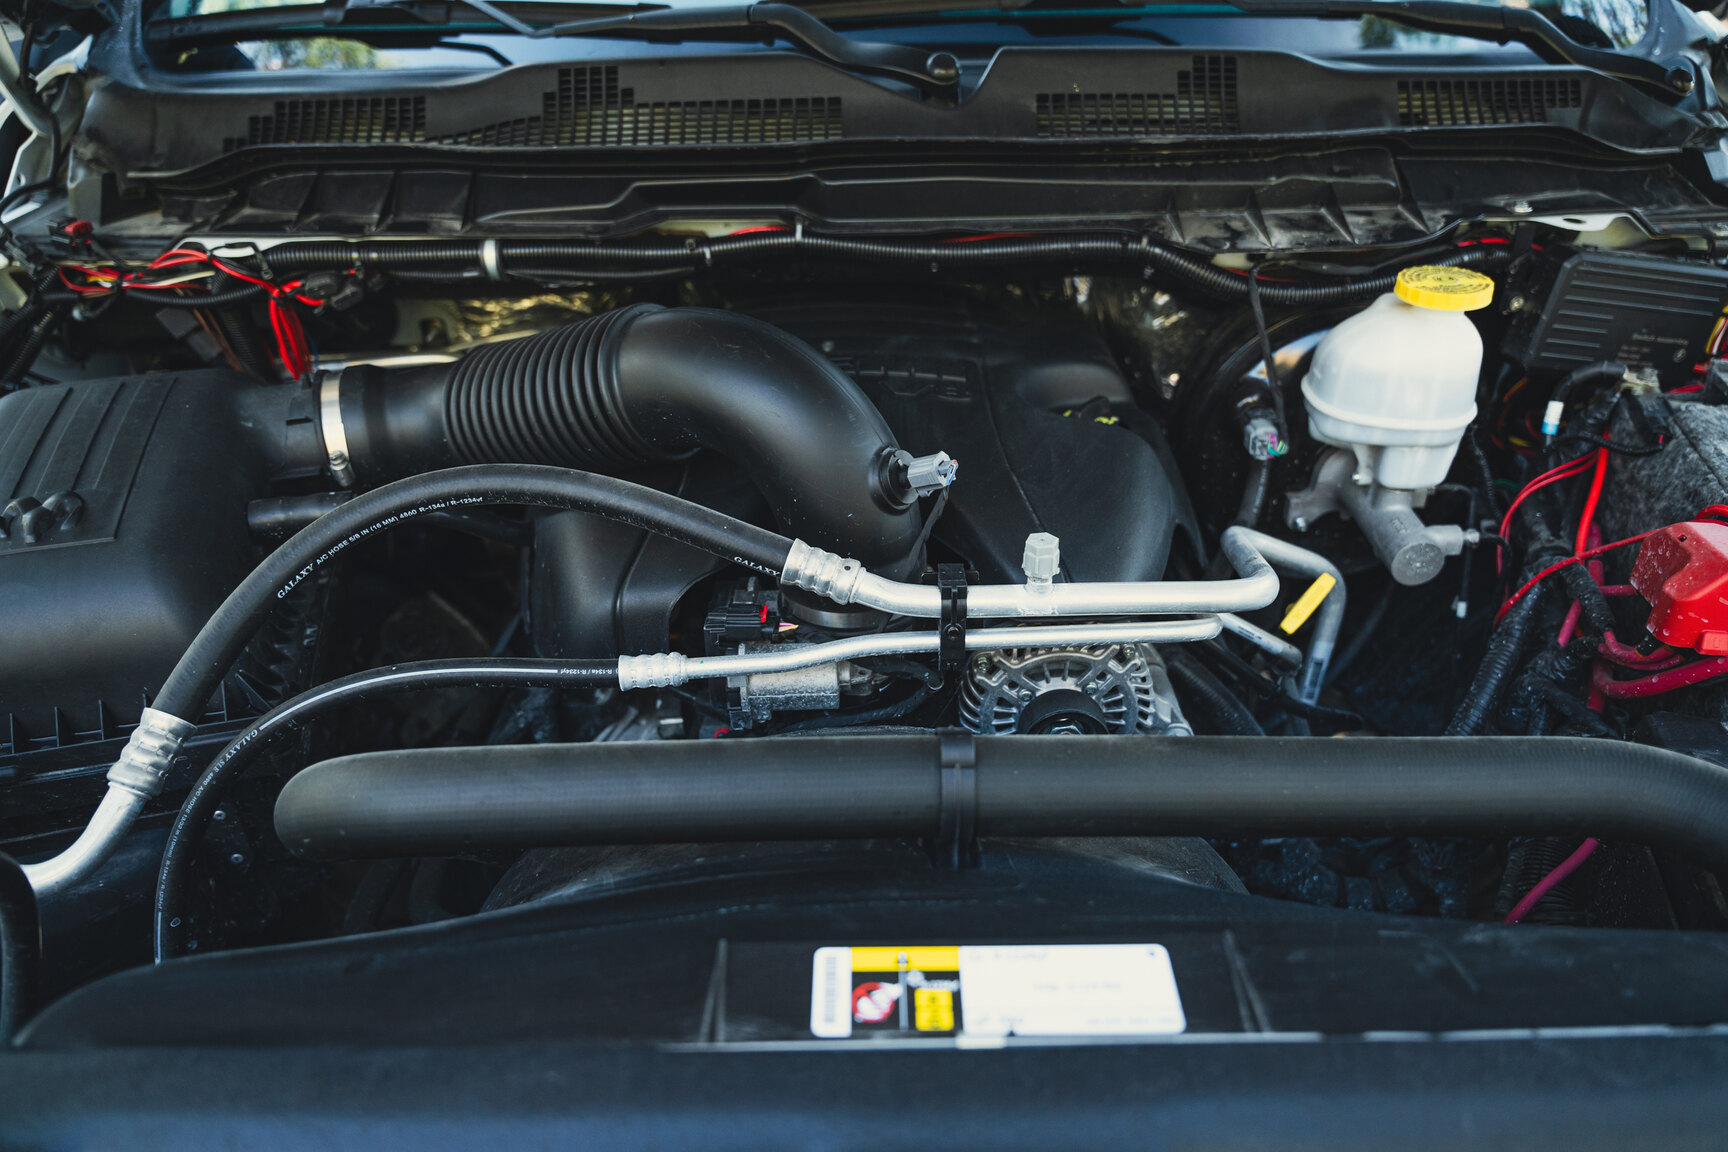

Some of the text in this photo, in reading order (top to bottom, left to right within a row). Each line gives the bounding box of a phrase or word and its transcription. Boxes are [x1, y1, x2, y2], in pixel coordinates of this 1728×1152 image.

[277, 562, 314, 599] GALAXY
[316, 553, 328, 565] A/C
[328, 539, 349, 556] HOSE
[360, 528, 370, 536] IN
[369, 522, 382, 532] (16
[381, 515, 399, 525] MM)
[733, 556, 781, 576] GALAXY
[225, 729, 258, 762] GALAXY
[185, 796, 198, 814] HOSE
